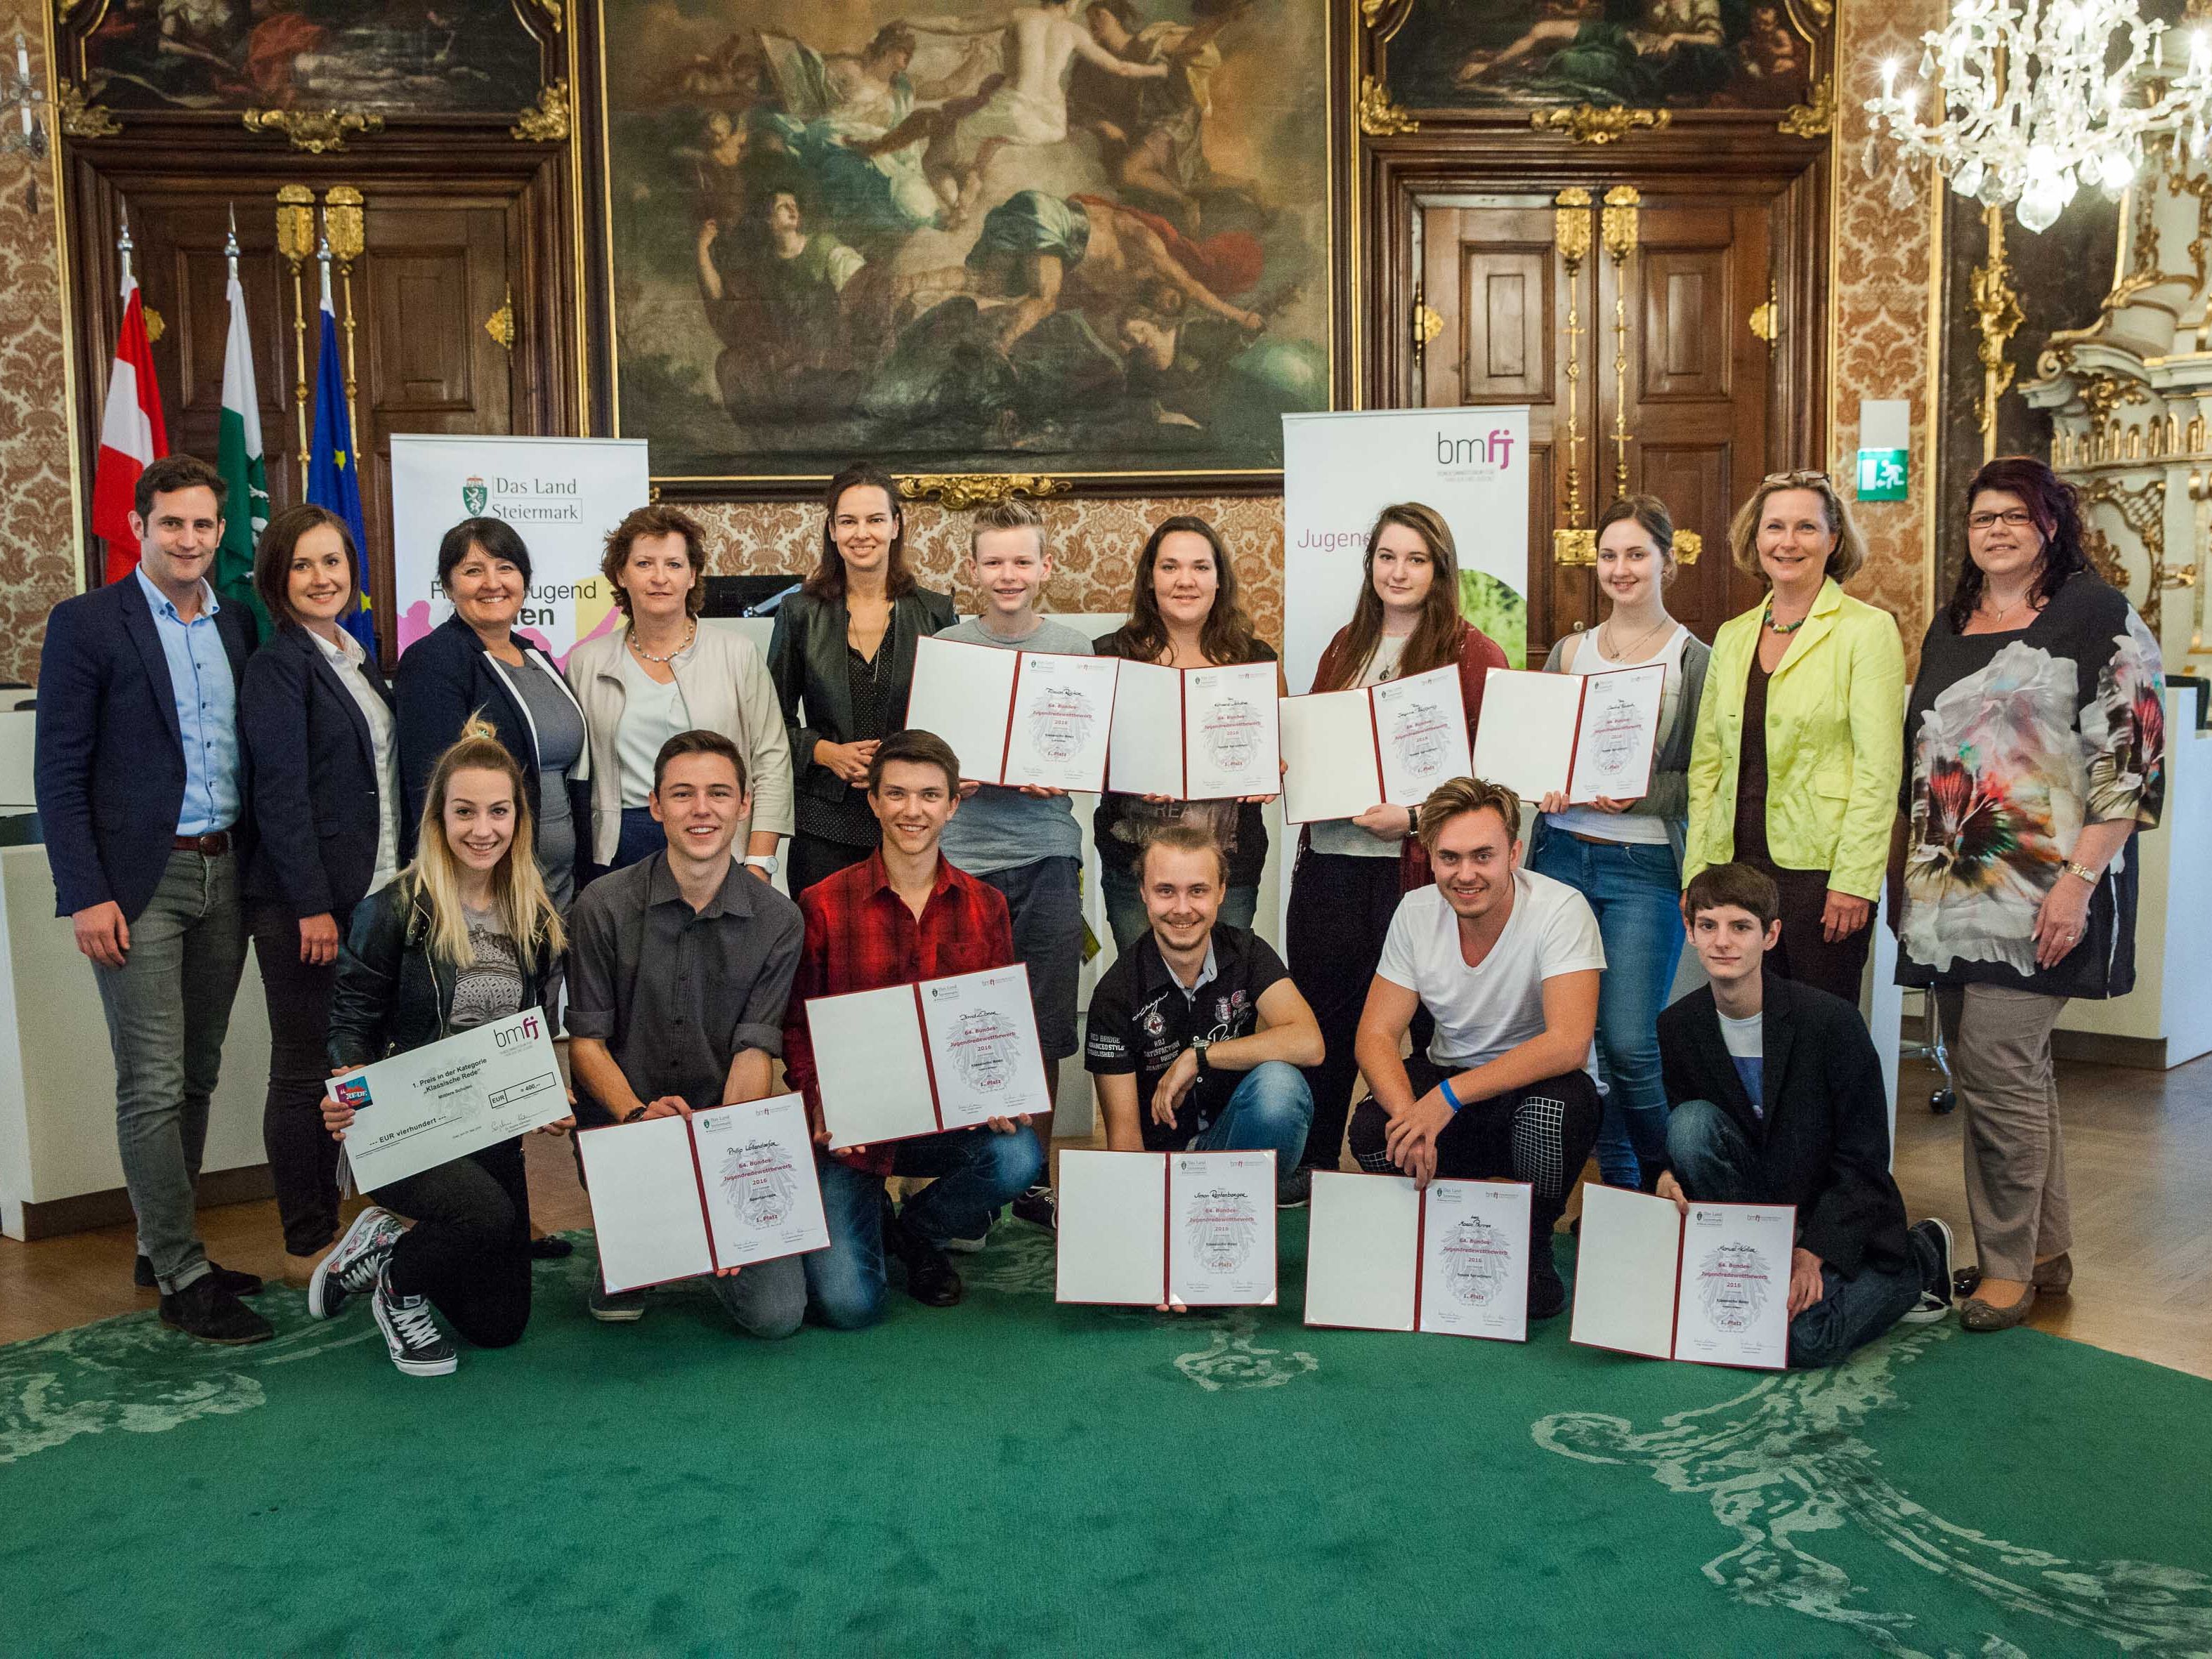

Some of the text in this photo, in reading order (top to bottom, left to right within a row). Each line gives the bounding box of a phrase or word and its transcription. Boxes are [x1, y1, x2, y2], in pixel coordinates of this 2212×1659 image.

[497, 478, 576, 494] Das Land
[492, 504, 578, 518] Steiermark
[530, 580, 596, 604] ugend
[419, 1076, 436, 1087] Preis
[457, 1058, 487, 1073] Kategorie
[492, 1095, 505, 1103] EUR
[379, 1132, 395, 1143] EUR
[396, 1117, 437, 1136] vierhundert
